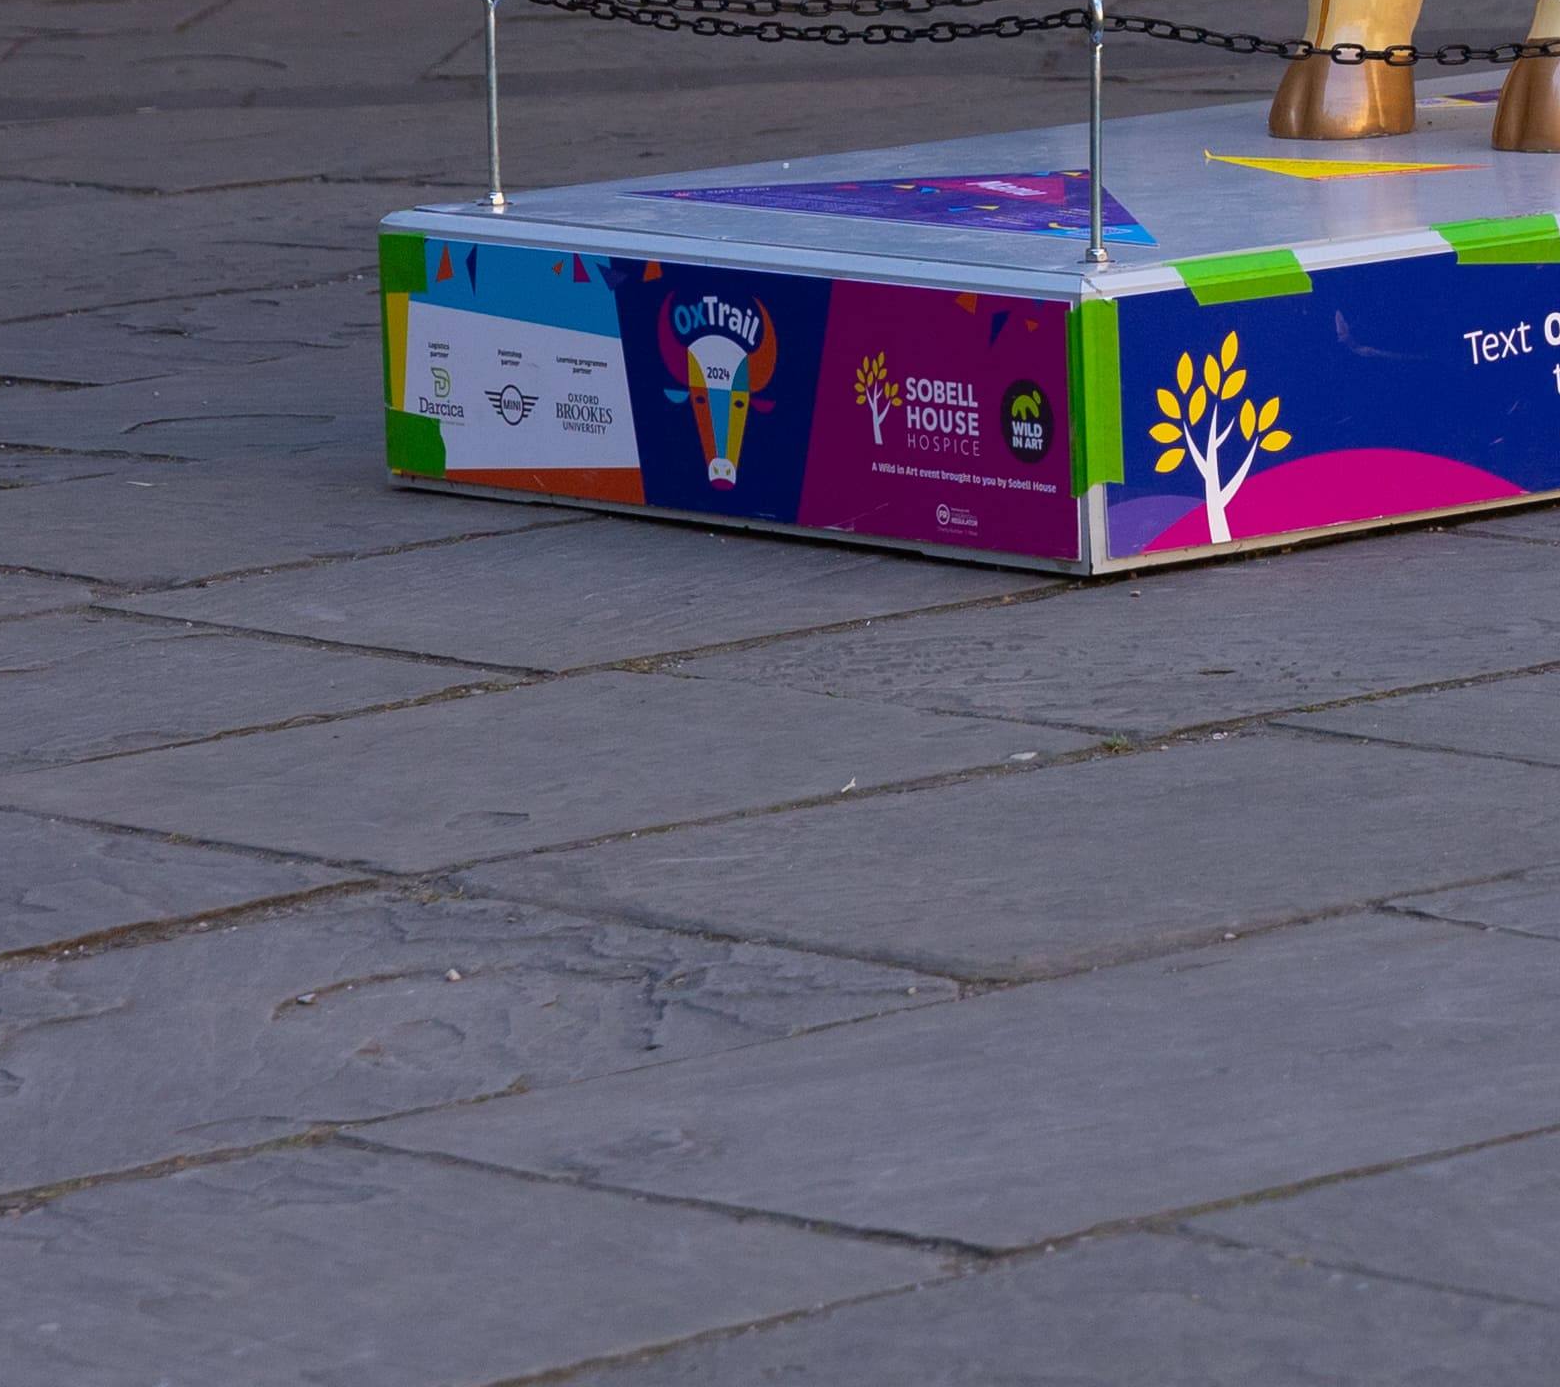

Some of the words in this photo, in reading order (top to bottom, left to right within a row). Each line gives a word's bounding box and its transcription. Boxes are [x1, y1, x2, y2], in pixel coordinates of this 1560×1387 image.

[674, 296, 759, 346] OxTrail
[1464, 321, 1532, 365] Text
[707, 367, 730, 381] 2024
[568, 393, 599, 405] OXFORD
[906, 377, 978, 407] SOBELL
[419, 397, 464, 418] Darcica
[503, 399, 521, 412] MINI
[556, 403, 613, 424] BROOKES
[562, 421, 606, 435] UNIVERSITY
[906, 406, 980, 436] HOUSE
[1012, 421, 1043, 437] WILD
[907, 433, 980, 457] HOSPICE
[1012, 436, 1023, 448] IN
[1025, 438, 1043, 450] ART
[872, 462, 878, 472] A
[878, 462, 896, 474] Wild
[897, 464, 904, 475] in
[905, 466, 918, 476] Art
[920, 469, 940, 479] event
[941, 469, 971, 484] brought
[972, 474, 981, 484] to
[982, 476, 996, 487] you
[997, 477, 1007, 489] by
[1008, 478, 1032, 491] Sobell
[1033, 481, 1057, 493] House
